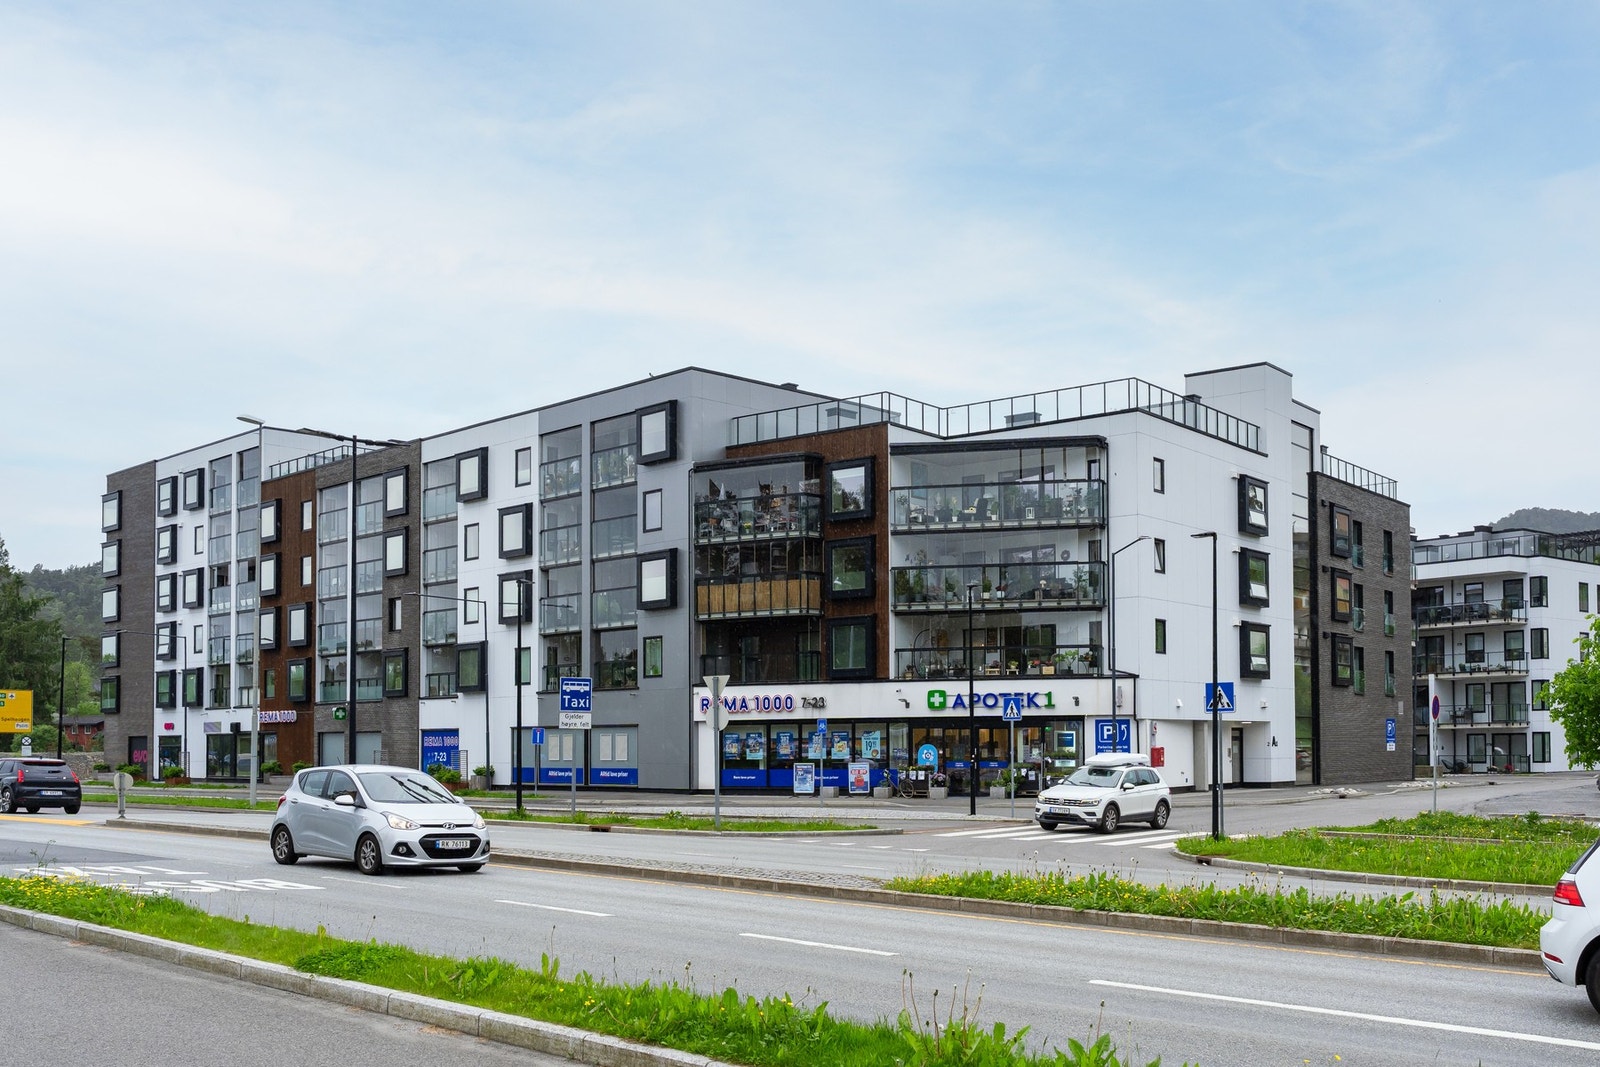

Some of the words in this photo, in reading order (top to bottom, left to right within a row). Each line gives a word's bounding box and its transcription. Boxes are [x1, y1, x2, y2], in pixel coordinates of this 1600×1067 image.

[563, 695, 589, 708] Taxi
[700, 695, 749, 713] RMA
[753, 694, 795, 713] 1000
[801, 697, 826, 709] 7-23
[259, 711, 280, 723] REMA
[280, 710, 297, 722] 1000
[564, 713, 584, 721] Gjelder
[424, 736, 443, 747] REMA
[443, 735, 459, 747] 1000
[434, 752, 447, 762] 7-23
